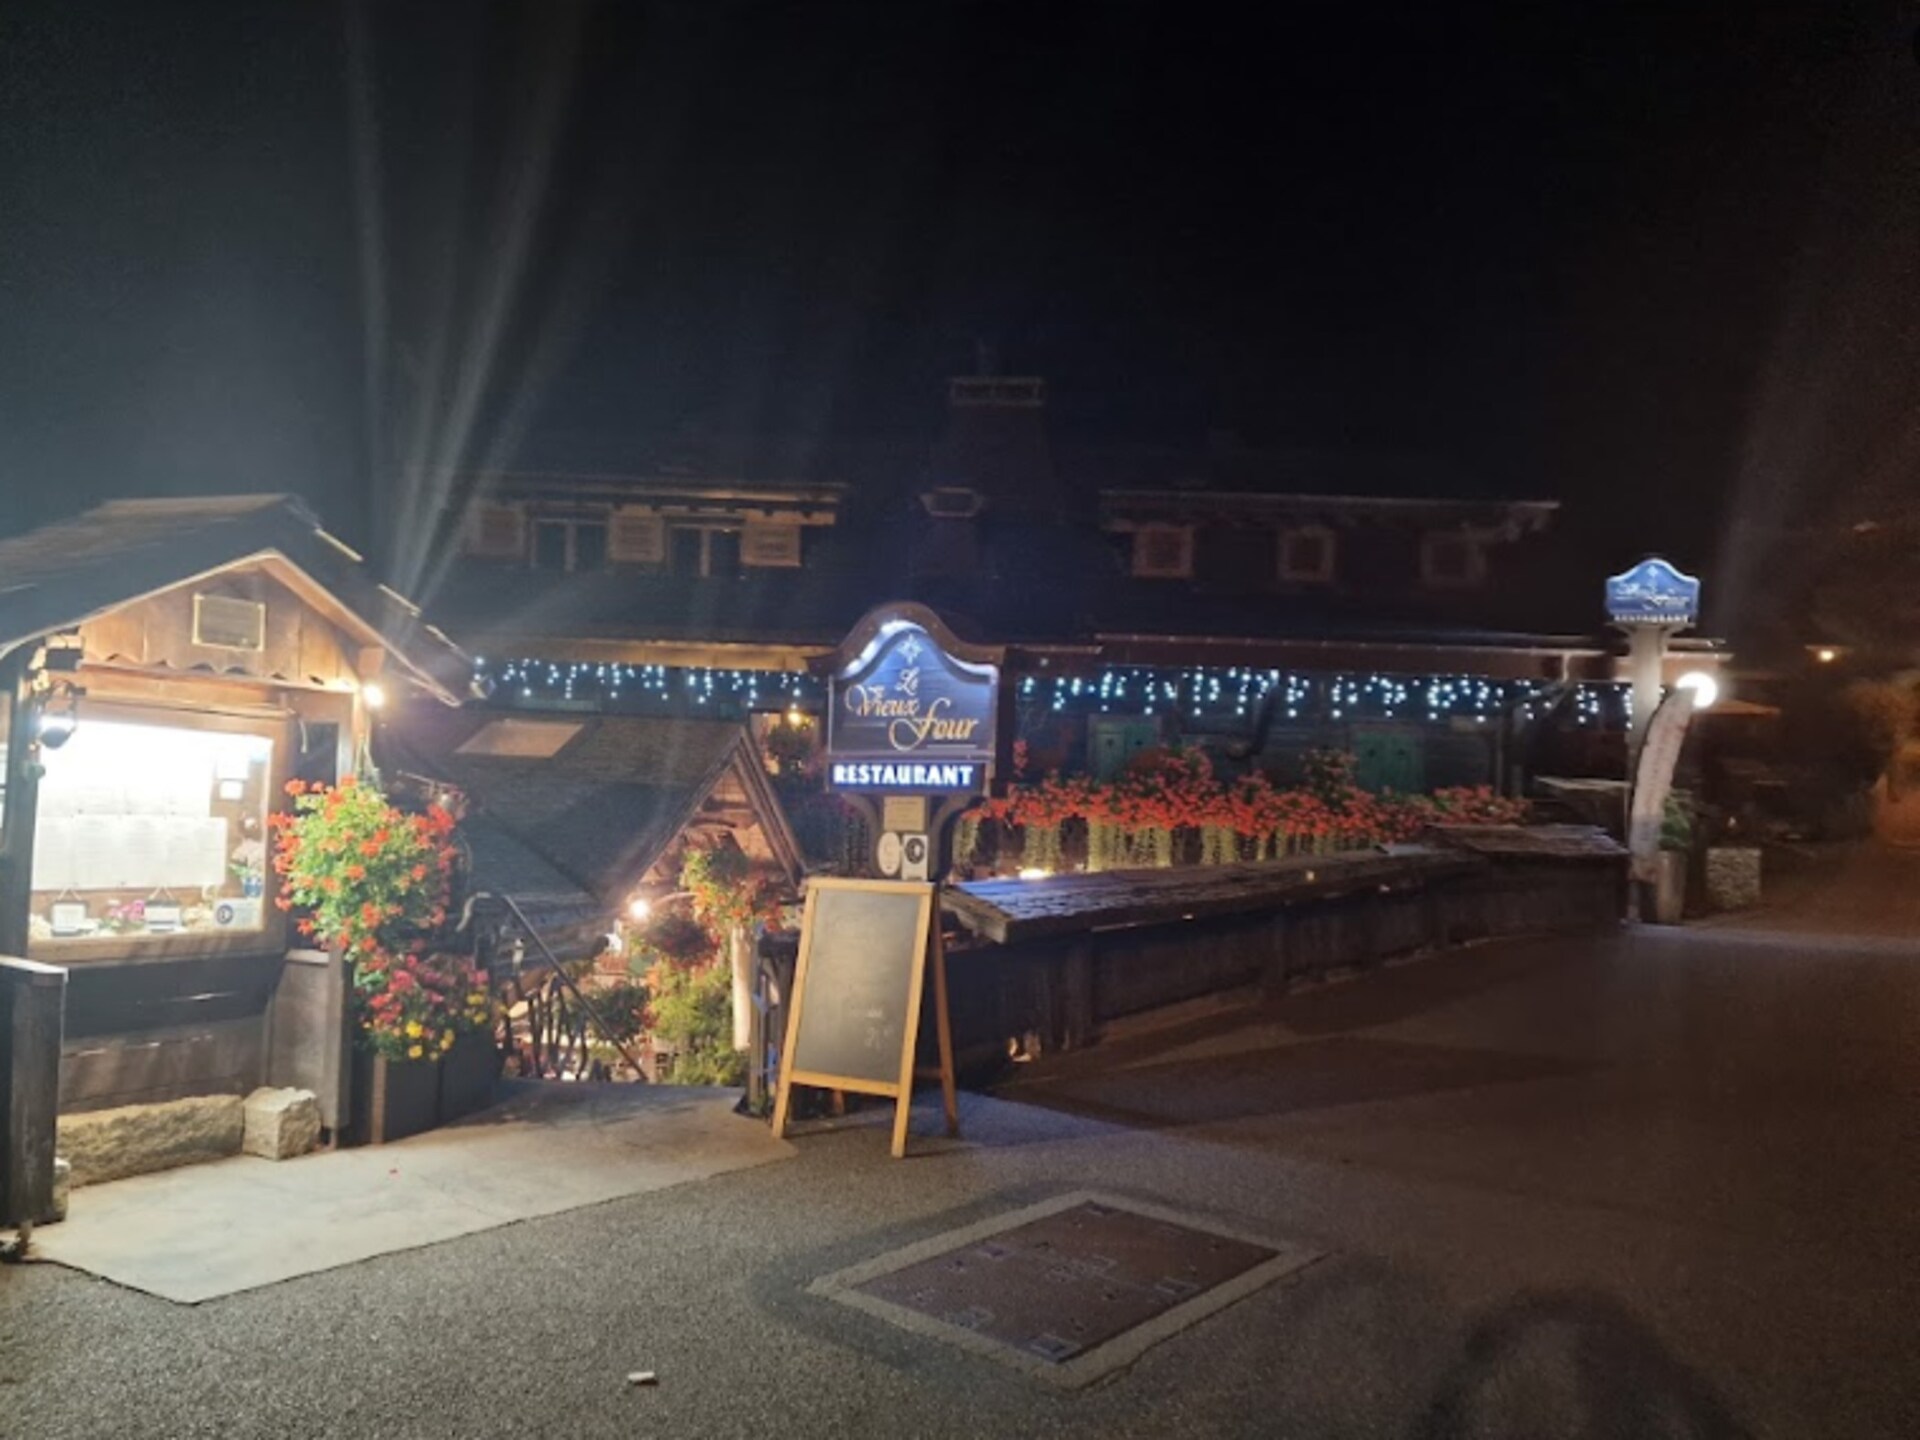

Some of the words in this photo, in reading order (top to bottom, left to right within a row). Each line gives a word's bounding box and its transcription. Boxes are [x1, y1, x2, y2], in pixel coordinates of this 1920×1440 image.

[895, 666, 919, 695] Le
[845, 684, 920, 717] Vieux
[833, 764, 974, 786] RESTAURANT
